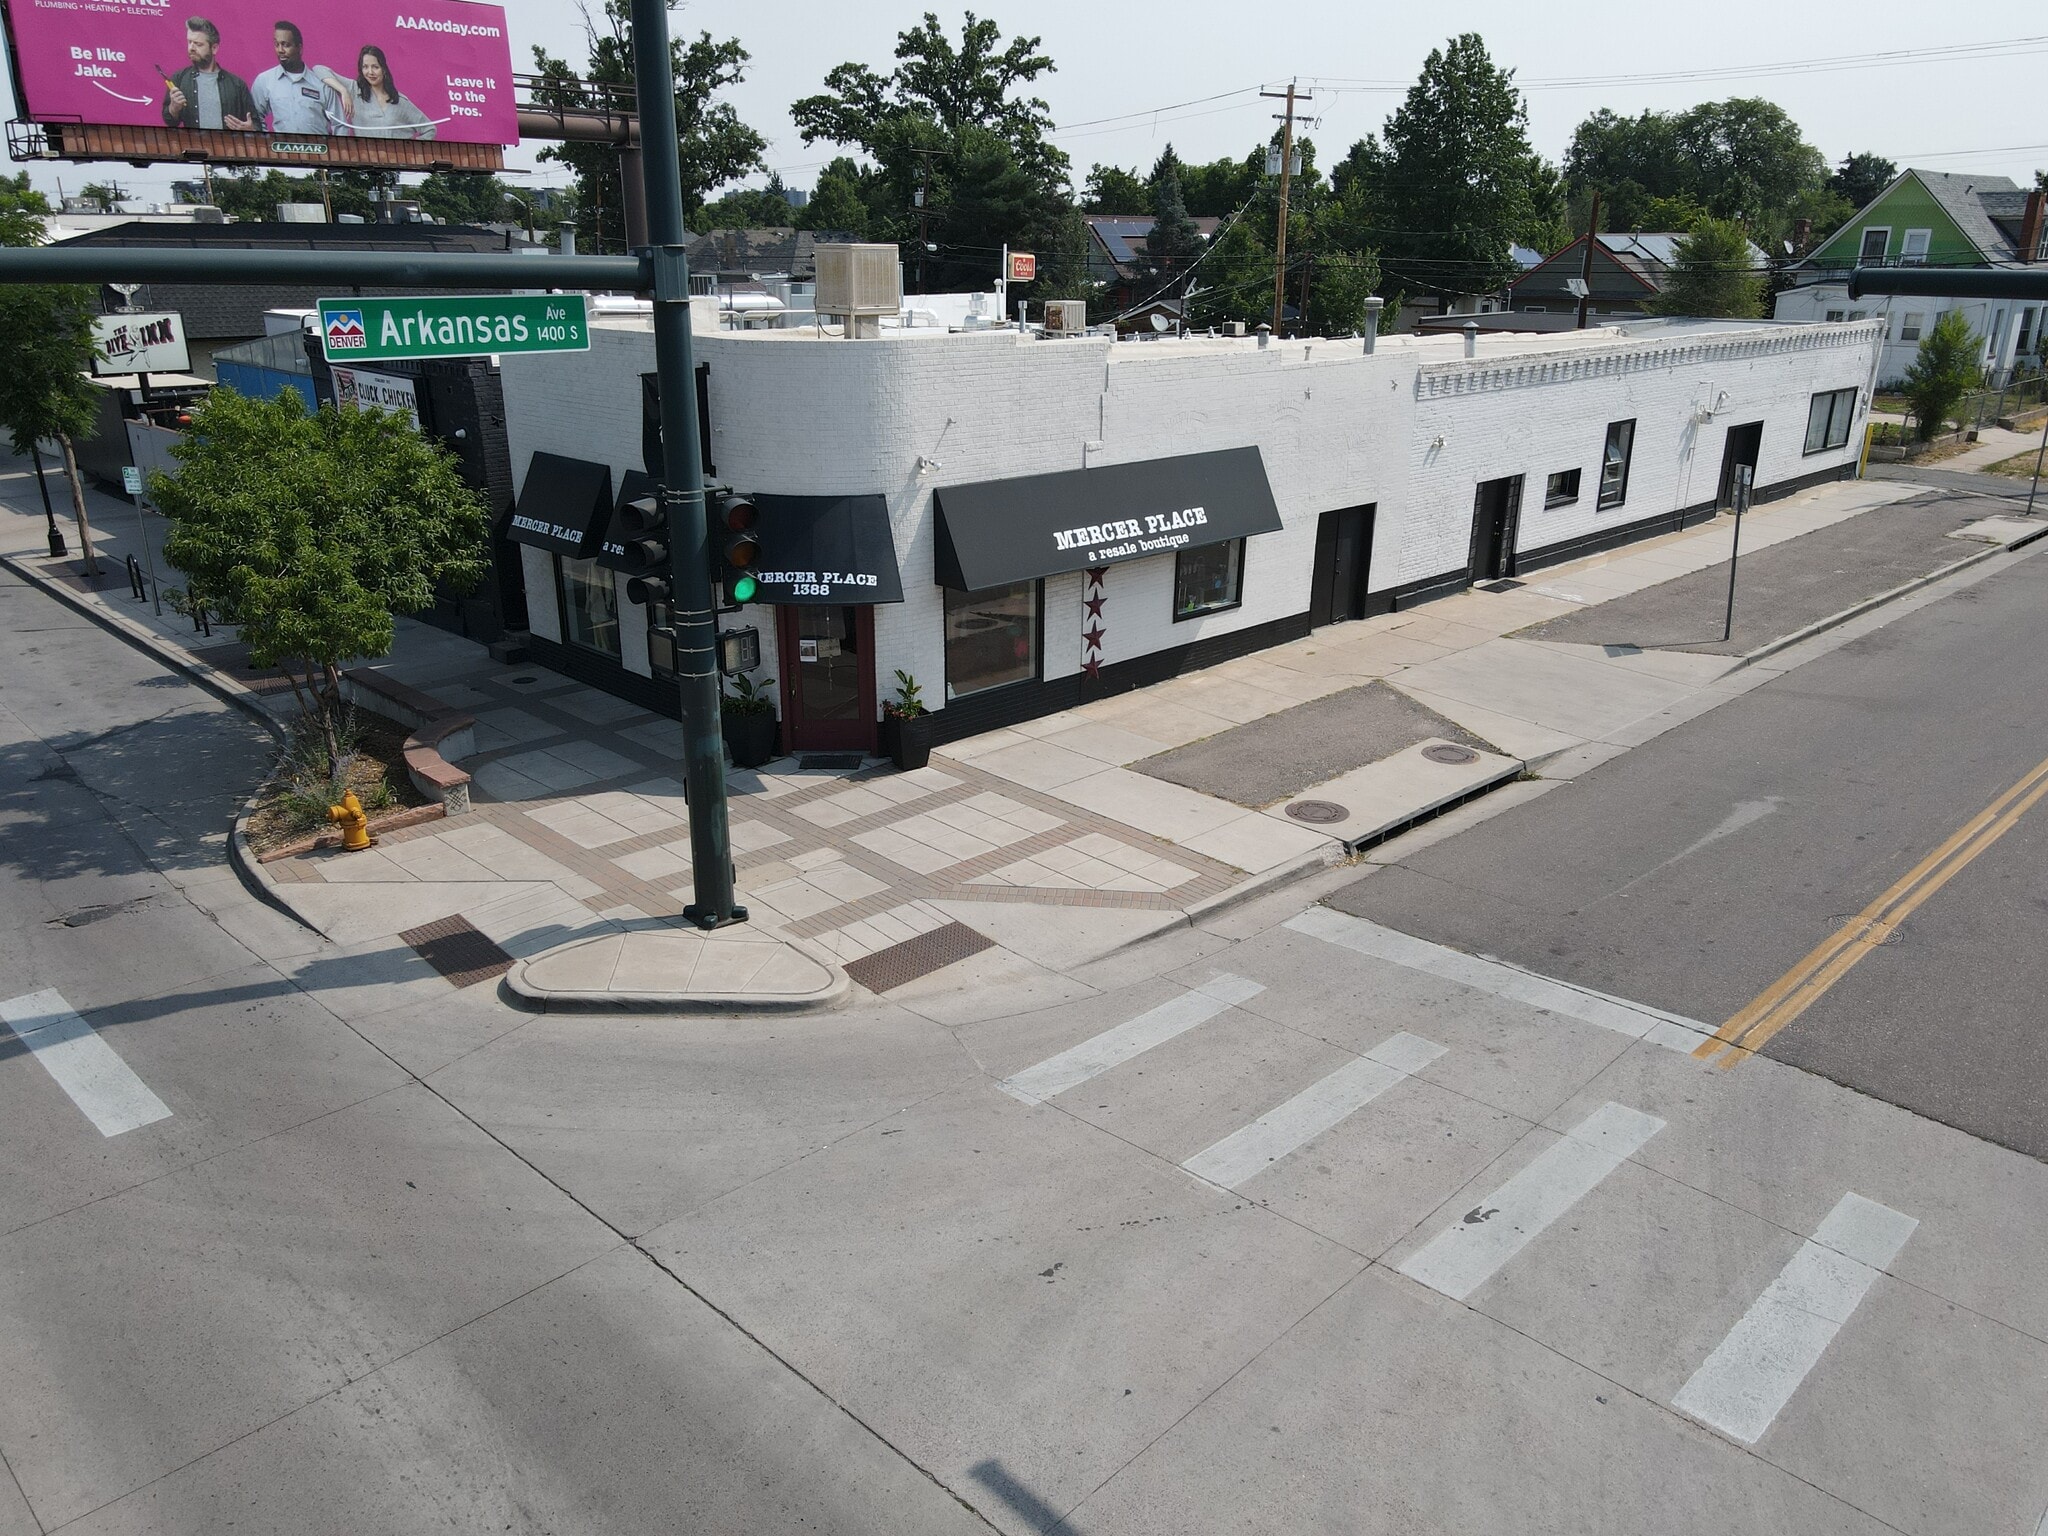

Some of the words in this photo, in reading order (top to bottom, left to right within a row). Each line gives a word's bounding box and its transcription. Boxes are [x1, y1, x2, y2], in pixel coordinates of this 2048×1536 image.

[35, 0, 78, 10] PLUMBING
[85, 3, 120, 13] HEATING
[127, 7, 164, 16] ELECTRIC
[396, 15, 500, 37] AAAtoday.com
[70, 46, 92, 60] Be
[97, 47, 126, 62] like
[74, 63, 117, 78] Jake.
[446, 75, 483, 88] Leave
[486, 77, 496, 89] it
[448, 90, 462, 101] to
[465, 91, 486, 103] the
[450, 104, 482, 117] Pros.
[276, 143, 322, 152] LAMAR
[380, 309, 528, 346] Arkansas
[546, 305, 566, 320] Ave
[537, 326, 566, 341] 1400
[570, 325, 578, 340] S
[329, 335, 366, 349] DENVER
[382, 387, 417, 410] CHICKEN
[511, 514, 551, 535] MERCER
[550, 524, 584, 544] PLACE
[1053, 518, 1144, 550] MERCER
[1145, 507, 1207, 533] PLACE
[602, 541, 610, 551] a
[1088, 551, 1098, 562] a
[1099, 543, 1138, 560] resale
[1138, 533, 1190, 551] boutique
[822, 572, 878, 587] PLACE
[792, 583, 830, 596] 1388
